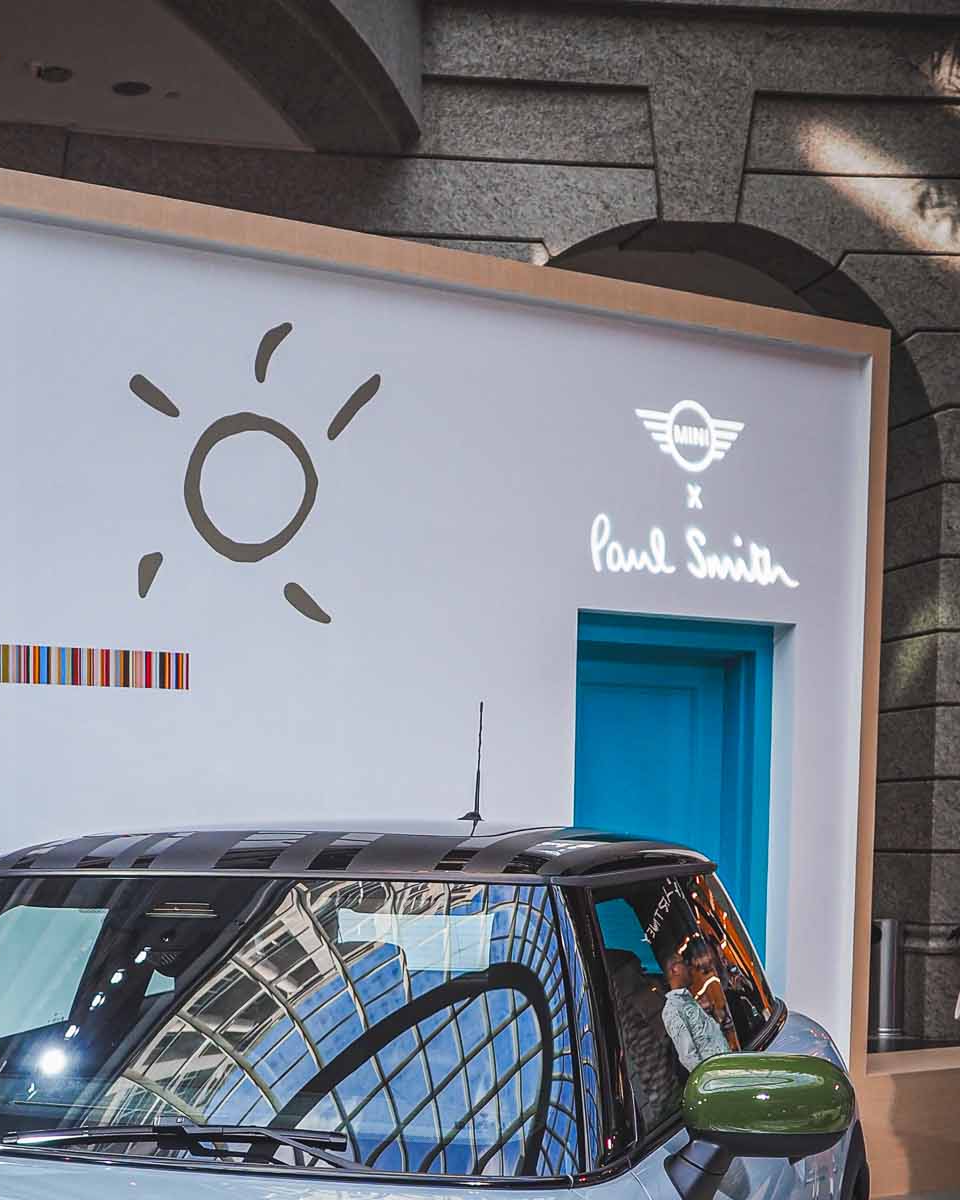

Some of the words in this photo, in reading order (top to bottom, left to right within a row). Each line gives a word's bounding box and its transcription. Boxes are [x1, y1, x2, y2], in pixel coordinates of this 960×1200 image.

[673, 424, 710, 448] MINI
[590, 512, 676, 575] Paul
[686, 526, 800, 588] Smith
